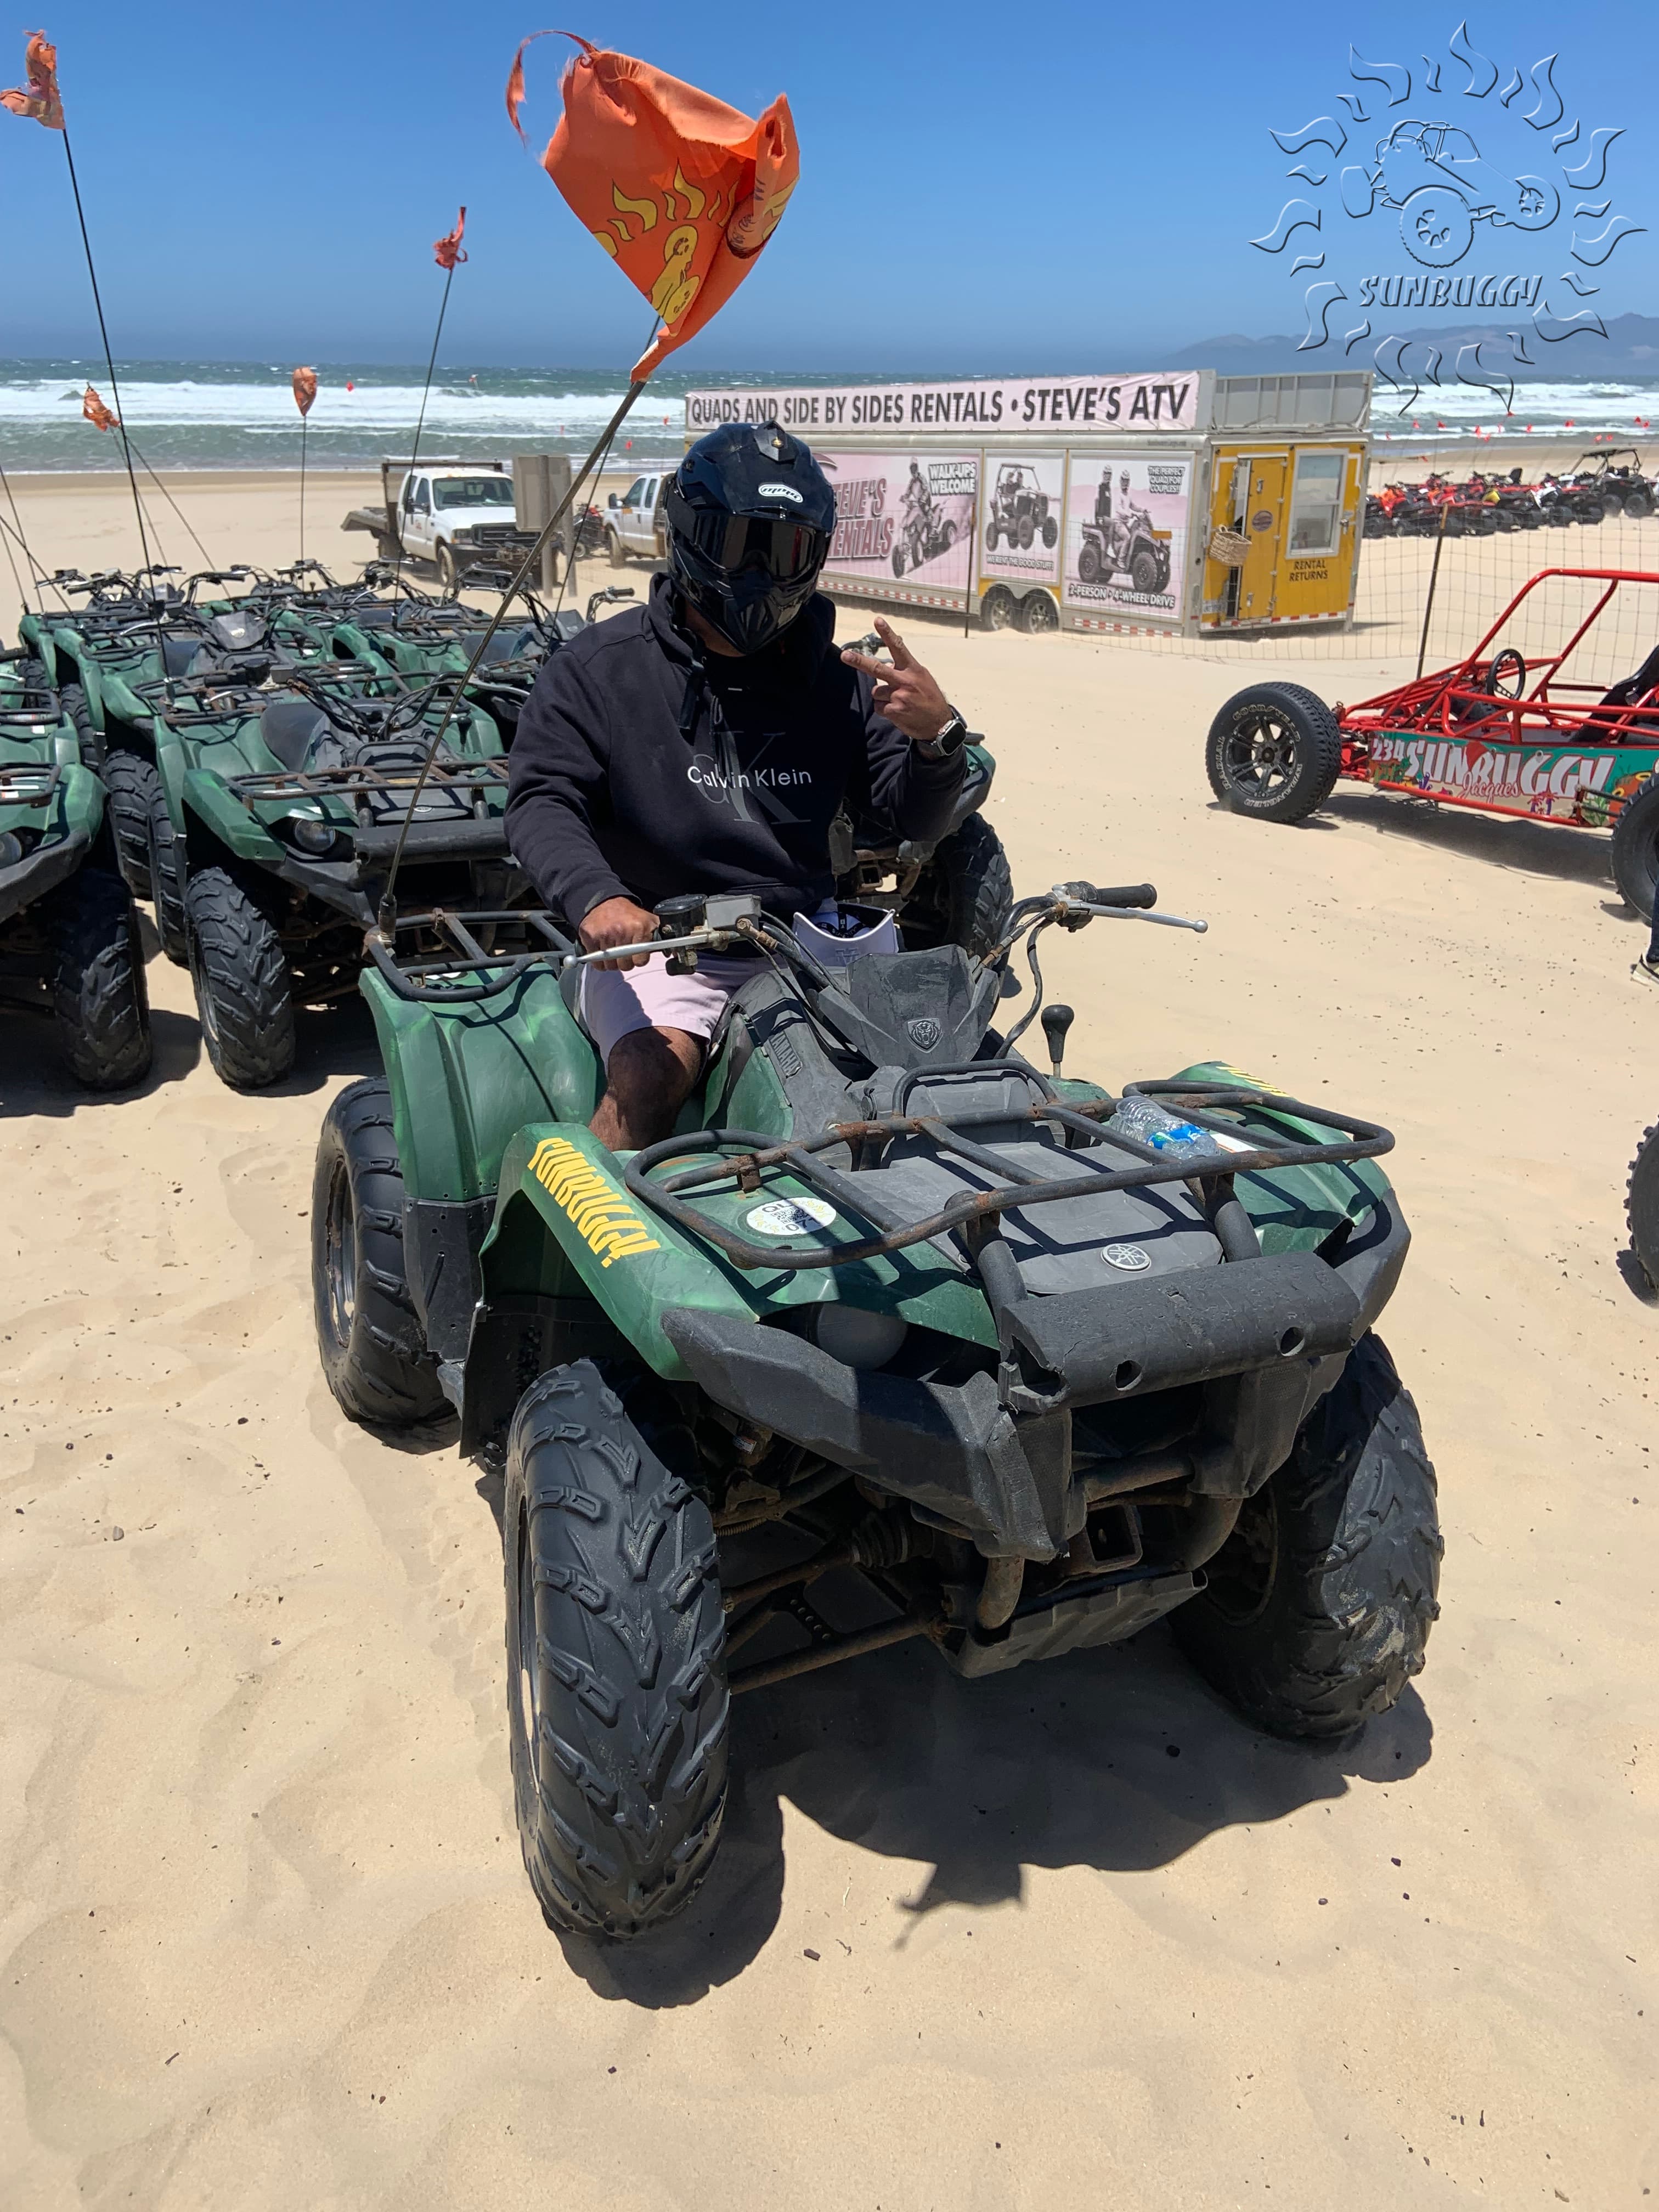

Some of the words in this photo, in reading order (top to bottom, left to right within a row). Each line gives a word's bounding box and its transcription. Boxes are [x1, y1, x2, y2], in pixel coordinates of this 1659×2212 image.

[692, 397, 740, 424] QUADS
[745, 398, 778, 422] AND
[784, 397, 819, 424] SIDE
[826, 396, 847, 423] BY
[852, 394, 904, 424] SIDES
[911, 390, 1003, 423] RENTALS
[1022, 386, 1121, 422] STEVE'S
[1129, 383, 1190, 420] ATV
[928, 461, 977, 479] WALK-UPS
[833, 478, 887, 517] TEVE'S
[930, 478, 976, 495] WELCOME
[1289, 569, 1328, 582] RETURNS
[1294, 560, 1326, 571] RENTAL
[1069, 583, 1107, 600] 2-PERSON
[1113, 589, 1149, 605] 4-WHEEL
[1150, 592, 1176, 608] DRIVE
[687, 763, 750, 789] Calvin
[754, 768, 812, 787] Klein
[1372, 738, 1405, 761] 234
[1403, 739, 1616, 800] SUNBUGGY
[1457, 770, 1521, 804] Jacques
[527, 1137, 661, 1268] SUNBUGGY
